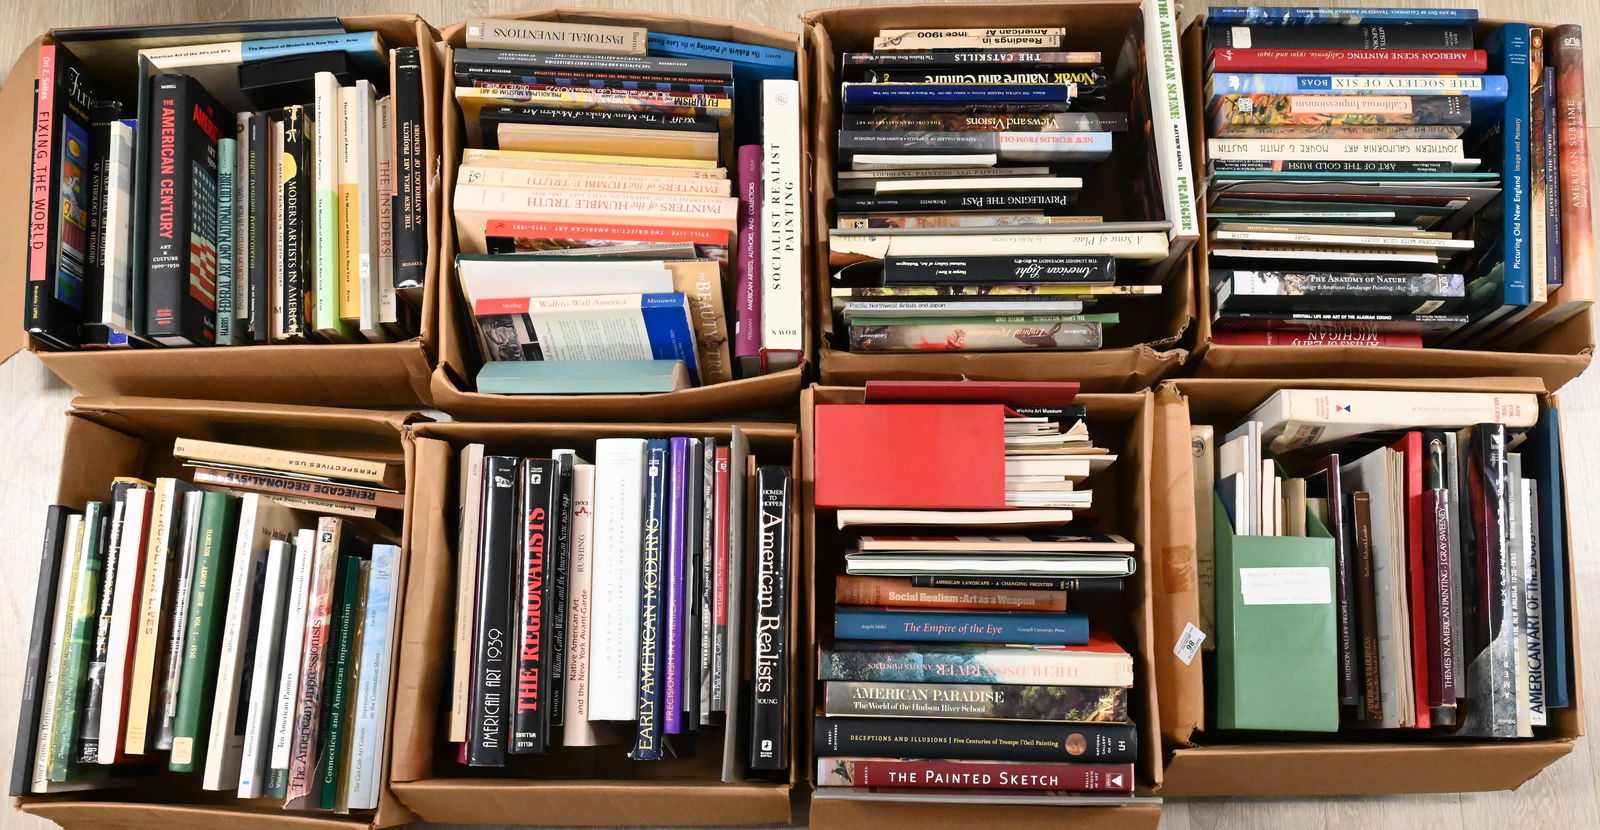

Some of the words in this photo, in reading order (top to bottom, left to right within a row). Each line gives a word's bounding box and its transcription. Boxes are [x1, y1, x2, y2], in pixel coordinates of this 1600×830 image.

[492, 26, 565, 41] INVENTIONS
[567, 31, 624, 45] PASTORAL
[994, 35, 1042, 45] Readings
[953, 53, 1013, 61] CATSKILLS
[1018, 53, 1041, 61] THE
[1159, 19, 1176, 80] AMERICAN
[977, 73, 1002, 83] and
[1003, 72, 1048, 83] Nature
[1053, 72, 1095, 85] Novak
[1300, 78, 1328, 87] BOAS
[1334, 78, 1358, 87] SIX
[1362, 78, 1380, 88] OF
[1386, 78, 1444, 88] SOCIETY
[1449, 78, 1478, 88] THE
[673, 97, 719, 107] FUTURISM
[1166, 82, 1181, 119] SCENE
[1295, 98, 1359, 110] Impressionism
[1361, 100, 1407, 111] California
[521, 107, 538, 116] Art
[539, 108, 572, 118] Modern
[572, 110, 582, 118] of
[584, 110, 611, 120] Masks
[612, 111, 637, 120] Many
[638, 113, 656, 122] The
[668, 116, 696, 124] Wolff
[965, 116, 1006, 129] Visions
[1006, 117, 1025, 129] and
[1026, 116, 1059, 129] Views
[1514, 117, 1522, 140] Memory
[1567, 100, 1577, 146] SUBLIME
[36, 110, 50, 159] FIXING
[160, 107, 174, 174] AMERICAN
[1288, 161, 1312, 170] RUSH
[1314, 162, 1341, 170] GOLD
[1343, 162, 1360, 170] THE
[1363, 162, 1375, 170] OF
[1378, 162, 1396, 170] ART
[1514, 152, 1522, 171] Image
[34, 165, 47, 192] THE
[379, 159, 390, 184] THE
[769, 142, 780, 204] REALIST
[1569, 150, 1580, 207] AMERICAN
[218, 172, 231, 203] CULTURE
[1513, 175, 1522, 201] England
[159, 178, 173, 238] CENTURY
[526, 196, 569, 208] TRUTH
[573, 198, 628, 210] HUMBLE
[630, 200, 644, 211] the
[645, 200, 657, 211] of
[659, 201, 721, 213] PAINTERS
[1175, 175, 1193, 231] PRAEGER
[31, 197, 46, 250] WORLD
[218, 205, 231, 242] NATIONAL
[378, 192, 392, 254] INSIDERS
[784, 181, 794, 251] PAINTING
[1513, 221, 1521, 235] Old
[219, 244, 231, 261] AND
[770, 210, 781, 290] SOCIALIST
[1513, 238, 1522, 268] Picturing
[218, 262, 231, 277] ART
[1014, 262, 1044, 278] Light
[1044, 264, 1097, 278] American
[218, 280, 231, 312] FEDERAL
[538, 298, 591, 308] Wall-to-Wall
[593, 297, 627, 306] America
[693, 278, 720, 339] BEAUTY
[220, 316, 228, 336] HARRIS
[287, 458, 306, 467] USA
[308, 460, 377, 476] PERSPECTIVES
[225, 472, 310, 493] REGIONALISTS
[313, 483, 376, 501] RENEGADE
[1438, 507, 1446, 541] SWEENEY
[576, 533, 585, 572] RUSHING
[642, 517, 661, 598] MODERNS
[759, 510, 783, 609] American
[520, 506, 548, 662] REGIONALISTS
[1440, 569, 1449, 605] PAINTING
[571, 598, 579, 612] Art
[1525, 594, 1539, 610] OF
[579, 588, 588, 639] Avant-Garde
[336, 603, 352, 665] Impressionism
[570, 613, 579, 652] American
[903, 621, 919, 632] The
[923, 622, 955, 634] Empire
[958, 622, 968, 634] of
[969, 622, 982, 633] the
[985, 623, 1003, 635] Eye
[1441, 606, 1450, 647] AMERICAN
[1525, 614, 1540, 639] ART
[485, 627, 505, 663] 1939
[578, 641, 586, 660] York
[640, 604, 658, 694] AMERICAN
[1185, 638, 1195, 651] 86
[1443, 647, 1451, 656] IN
[303, 618, 324, 704] Impressionists
[757, 615, 780, 693] Realists
[568, 653, 577, 680] Native
[578, 661, 586, 681] New
[1343, 651, 1351, 681] HUDSON
[1443, 656, 1452, 688] THEMES
[282, 672, 292, 700] Painters
[484, 668, 502, 687] ART
[1526, 641, 1543, 714] AMERICAN
[332, 667, 344, 709] American
[517, 667, 539, 714] THE
[577, 682, 585, 696] the
[665, 656, 675, 721] PRECISIONISM
[852, 687, 928, 701] AMERICAN
[932, 689, 1005, 703] PARADISE
[576, 698, 584, 715] and
[852, 701, 866, 709] The
[865, 701, 890, 710] World
[890, 702, 899, 710] of
[898, 702, 910, 710] the
[911, 702, 939, 712] Hudson
[941, 703, 960, 712] River
[961, 704, 985, 713] School
[278, 701, 289, 734] American
[330, 712, 339, 728] and
[480, 692, 501, 748] AMERICAN
[638, 696, 655, 750] EARLY
[277, 736, 285, 749] Ten
[294, 704, 313, 764] American
[850, 734, 892, 742] DECEPTIONS
[324, 730, 338, 783] Connecticut
[290, 766, 306, 791] The
[888, 771, 916, 783] THE
[925, 770, 991, 785] PAINTED
[999, 771, 1058, 786] SKETCH
